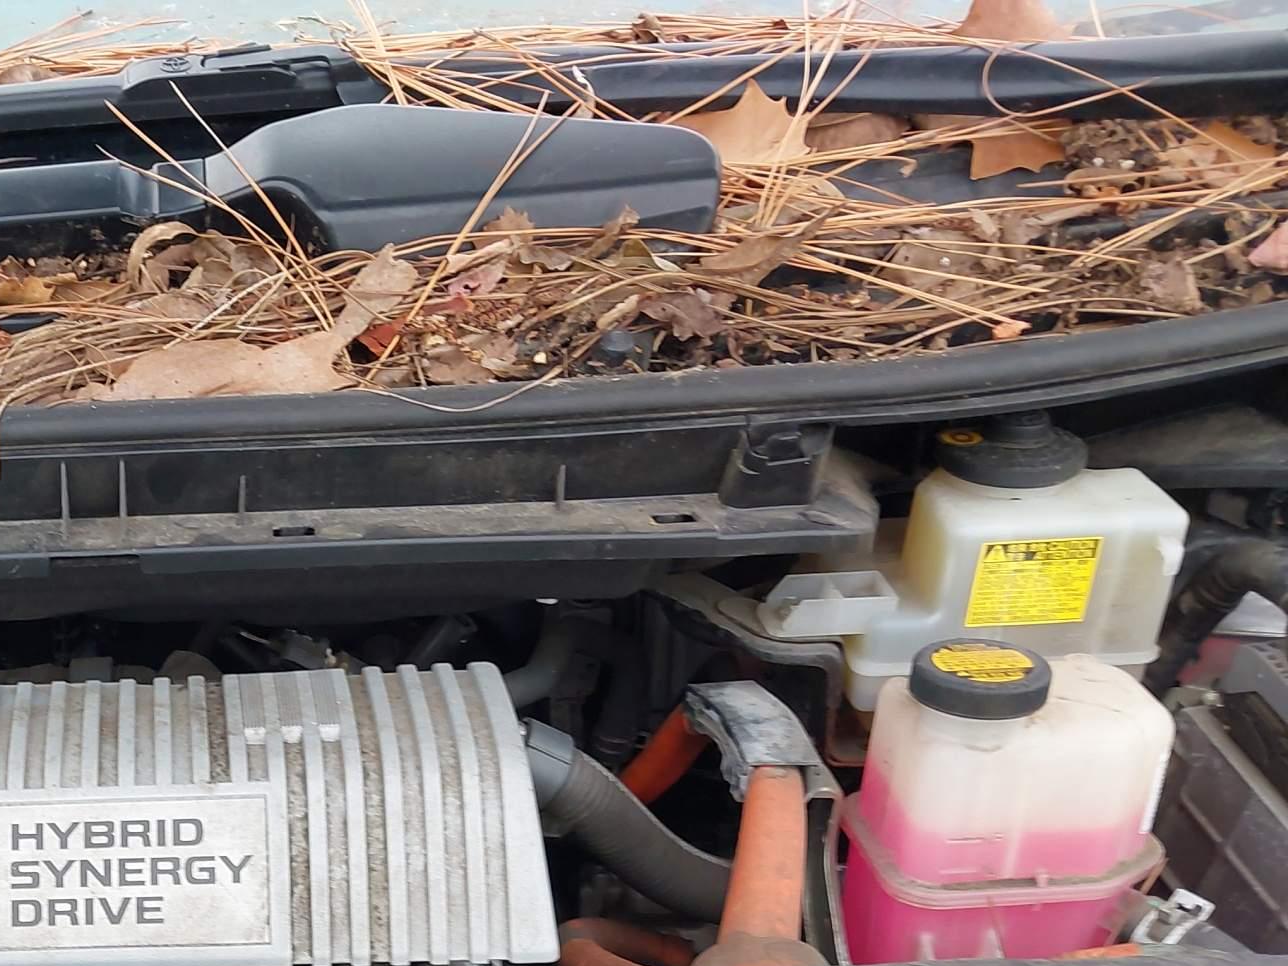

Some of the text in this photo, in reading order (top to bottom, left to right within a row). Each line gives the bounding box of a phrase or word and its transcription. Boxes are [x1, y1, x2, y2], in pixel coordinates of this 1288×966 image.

[11, 818, 203, 850] HYBRID
[10, 855, 254, 889] SYNERGY
[11, 896, 165, 927] DRIVE
